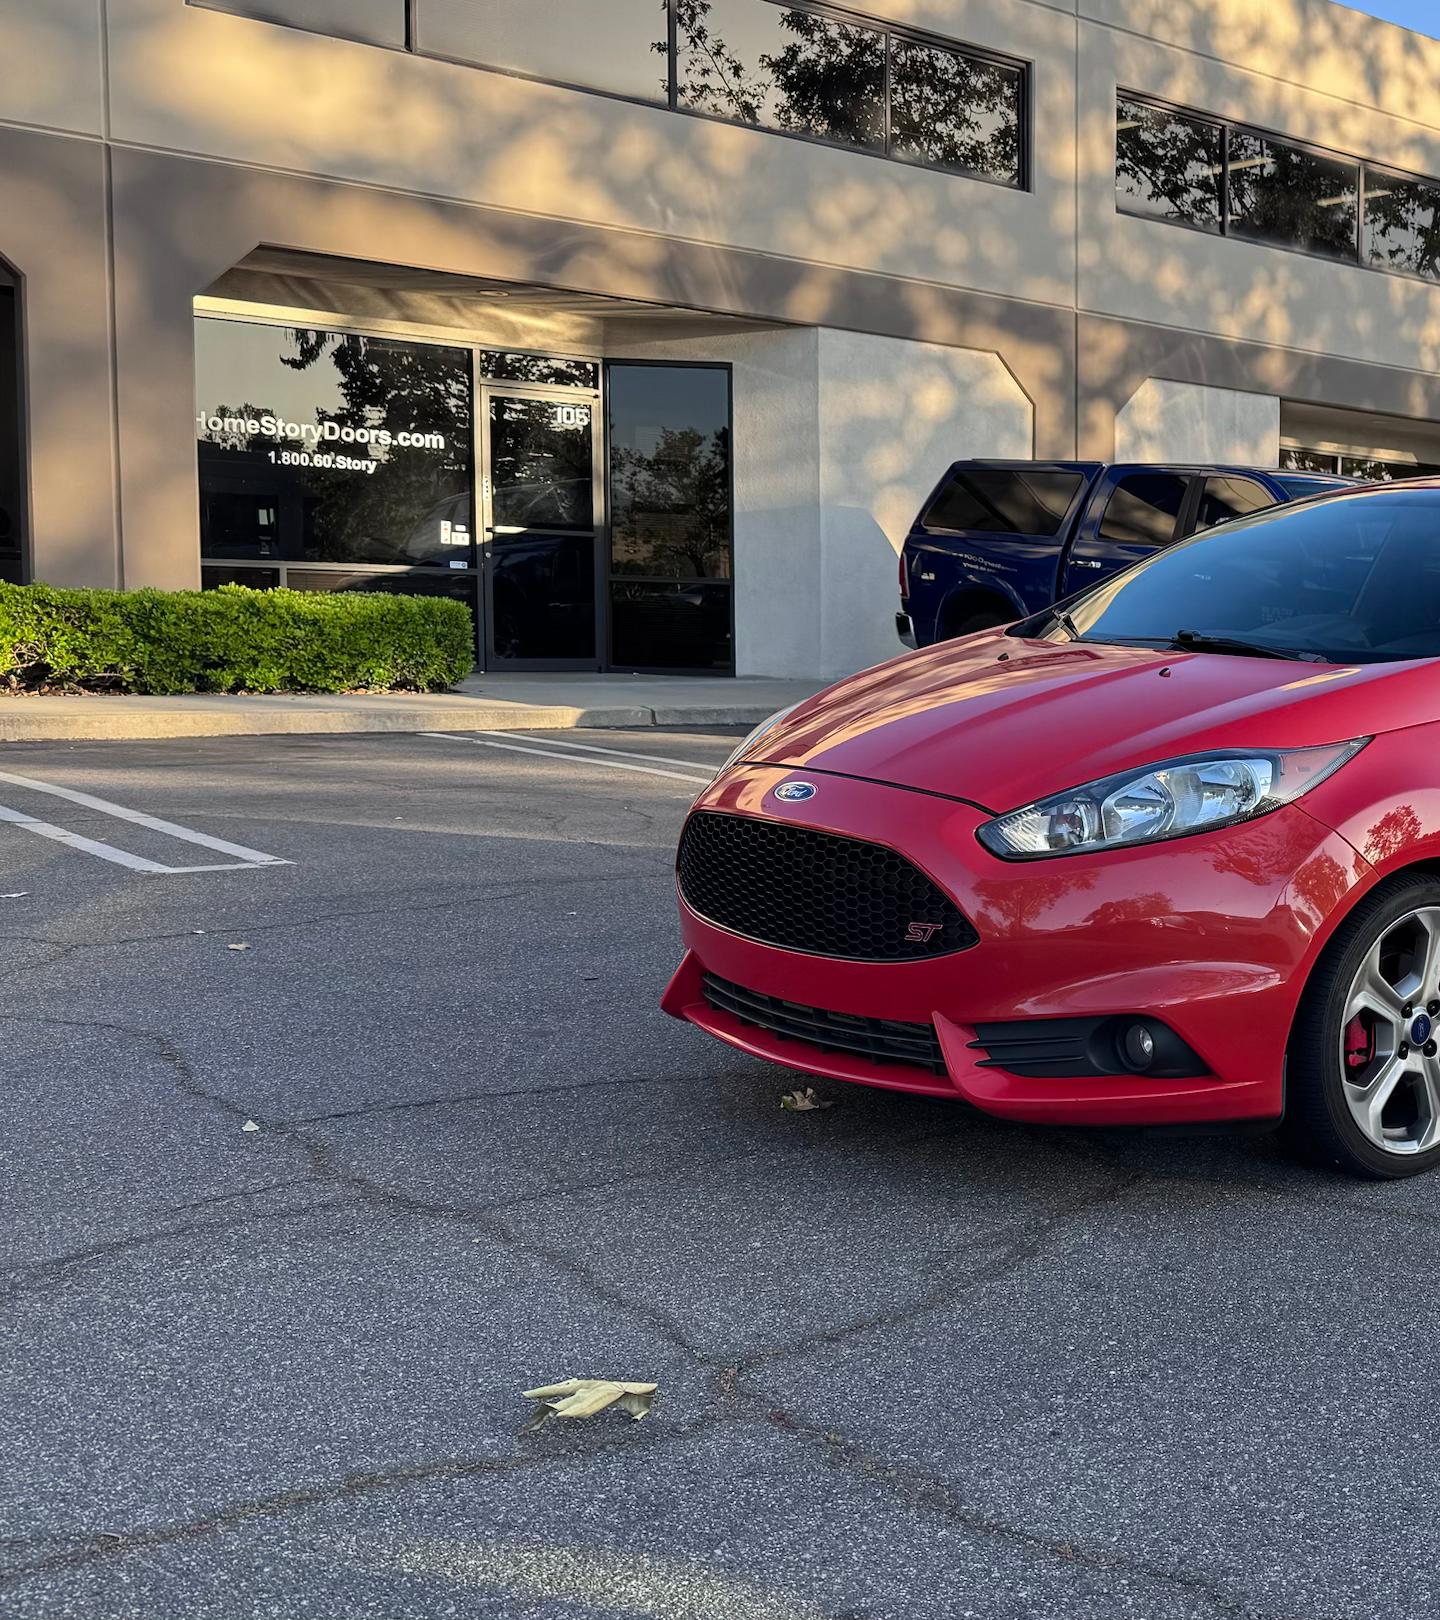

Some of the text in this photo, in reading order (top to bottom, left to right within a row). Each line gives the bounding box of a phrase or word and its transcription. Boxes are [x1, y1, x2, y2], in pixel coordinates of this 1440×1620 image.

[557, 406, 590, 426] 105
[268, 451, 377, 474] 1.800.60.Story
[778, 783, 809, 799] Ford
[904, 921, 943, 942] ST
